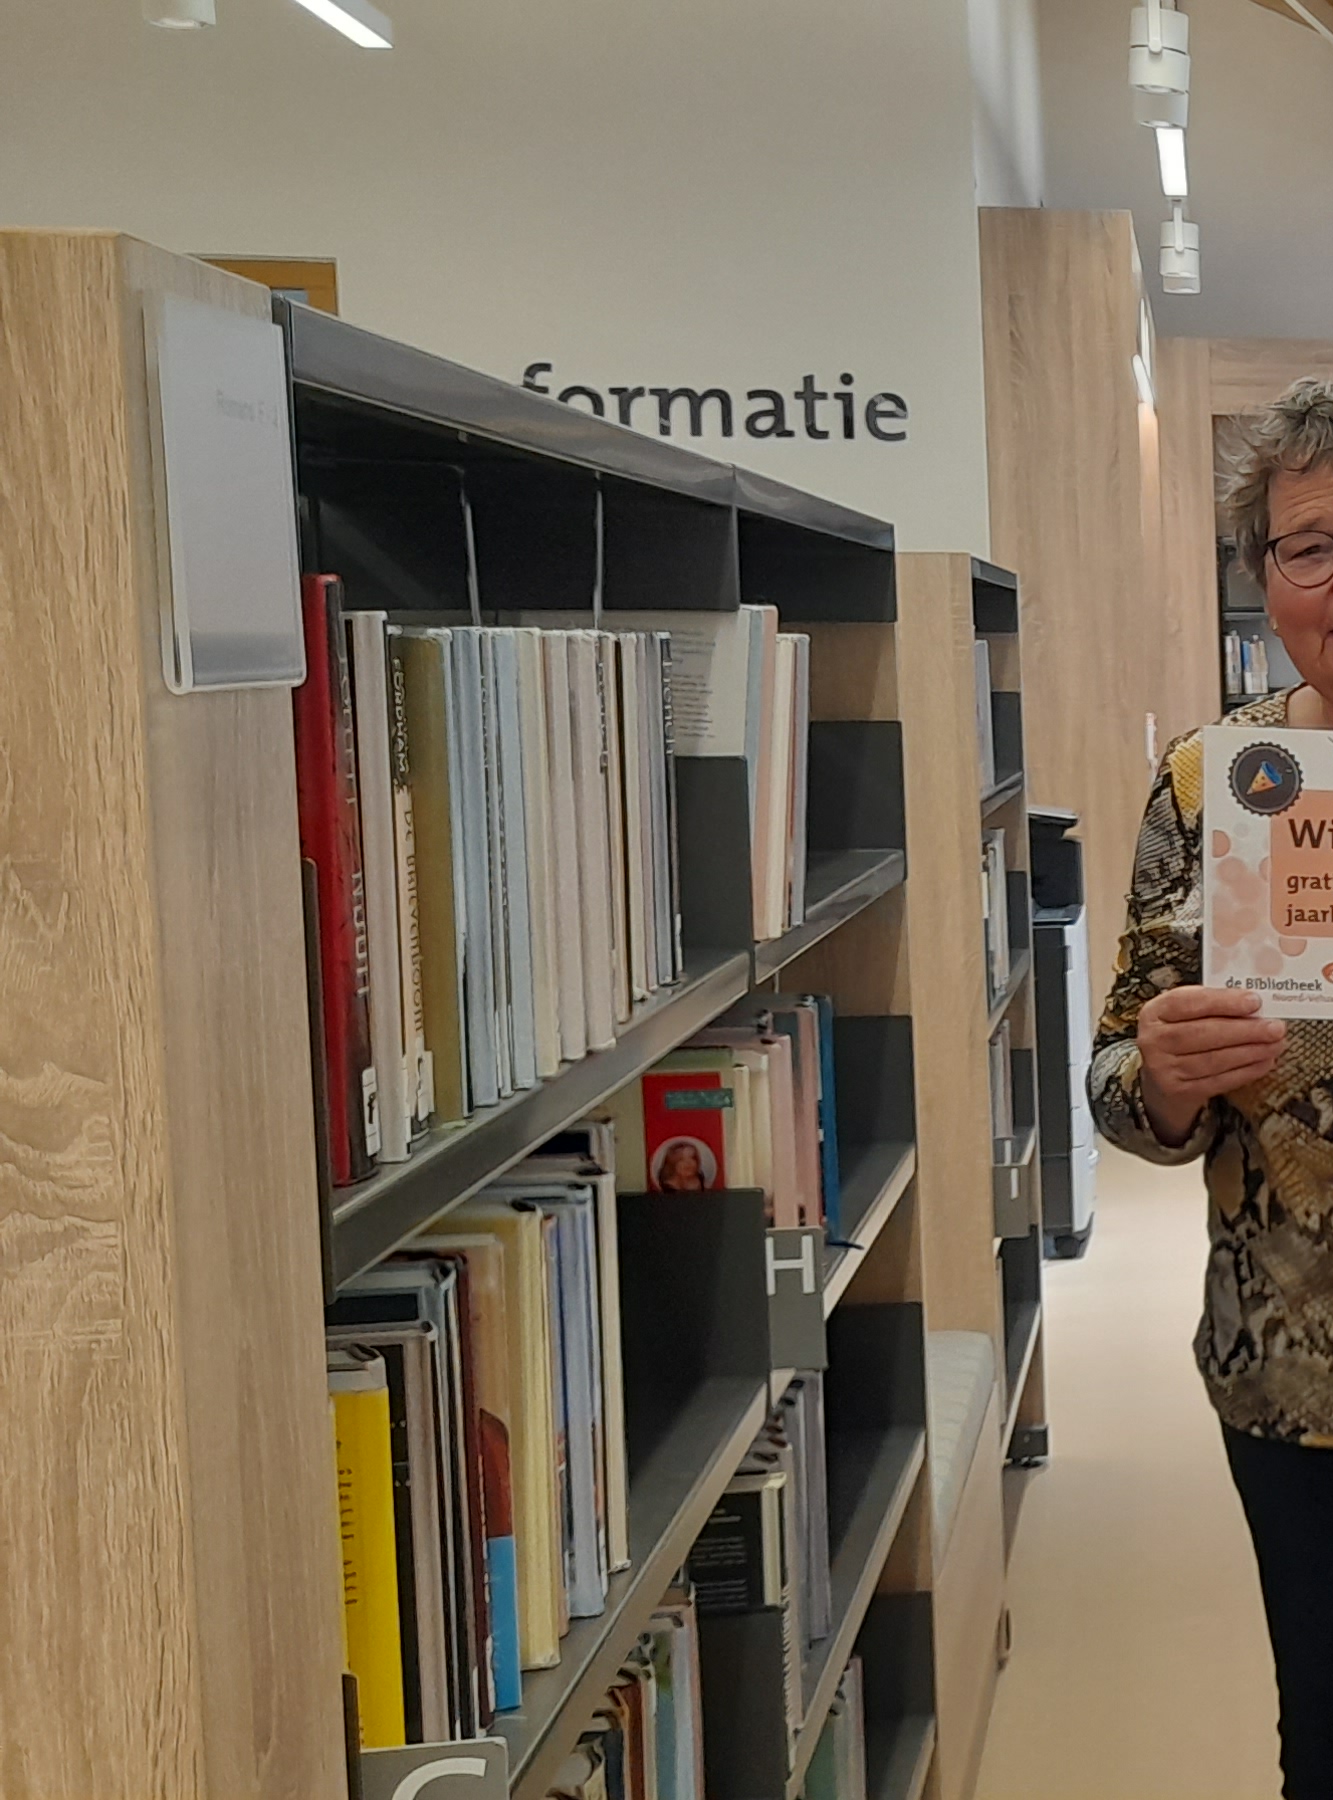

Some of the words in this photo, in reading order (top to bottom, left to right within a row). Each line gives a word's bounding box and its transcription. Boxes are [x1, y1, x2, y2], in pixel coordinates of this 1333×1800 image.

[1225, 976, 1242, 989] de
[1246, 977, 1323, 992] Bibliotheek
[765, 1234, 816, 1296] H
